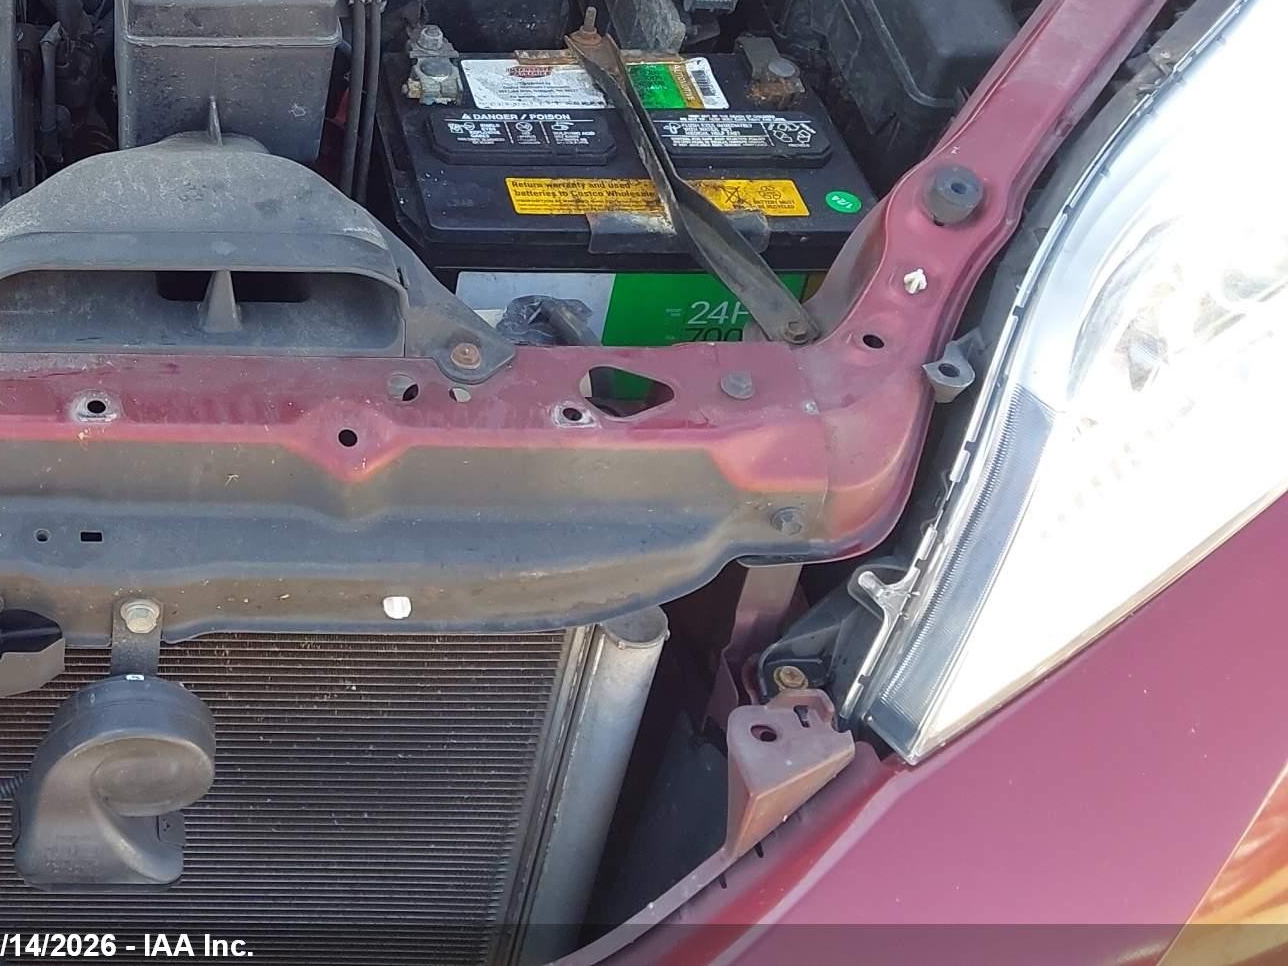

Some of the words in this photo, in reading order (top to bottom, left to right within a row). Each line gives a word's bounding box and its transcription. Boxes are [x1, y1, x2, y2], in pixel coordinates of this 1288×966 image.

[512, 181, 543, 189] Return
[545, 181, 586, 190] warranty
[588, 181, 606, 189] and
[515, 190, 556, 198] batteries
[570, 190, 604, 198] Costco
[605, 190, 655, 198] Wholesale
